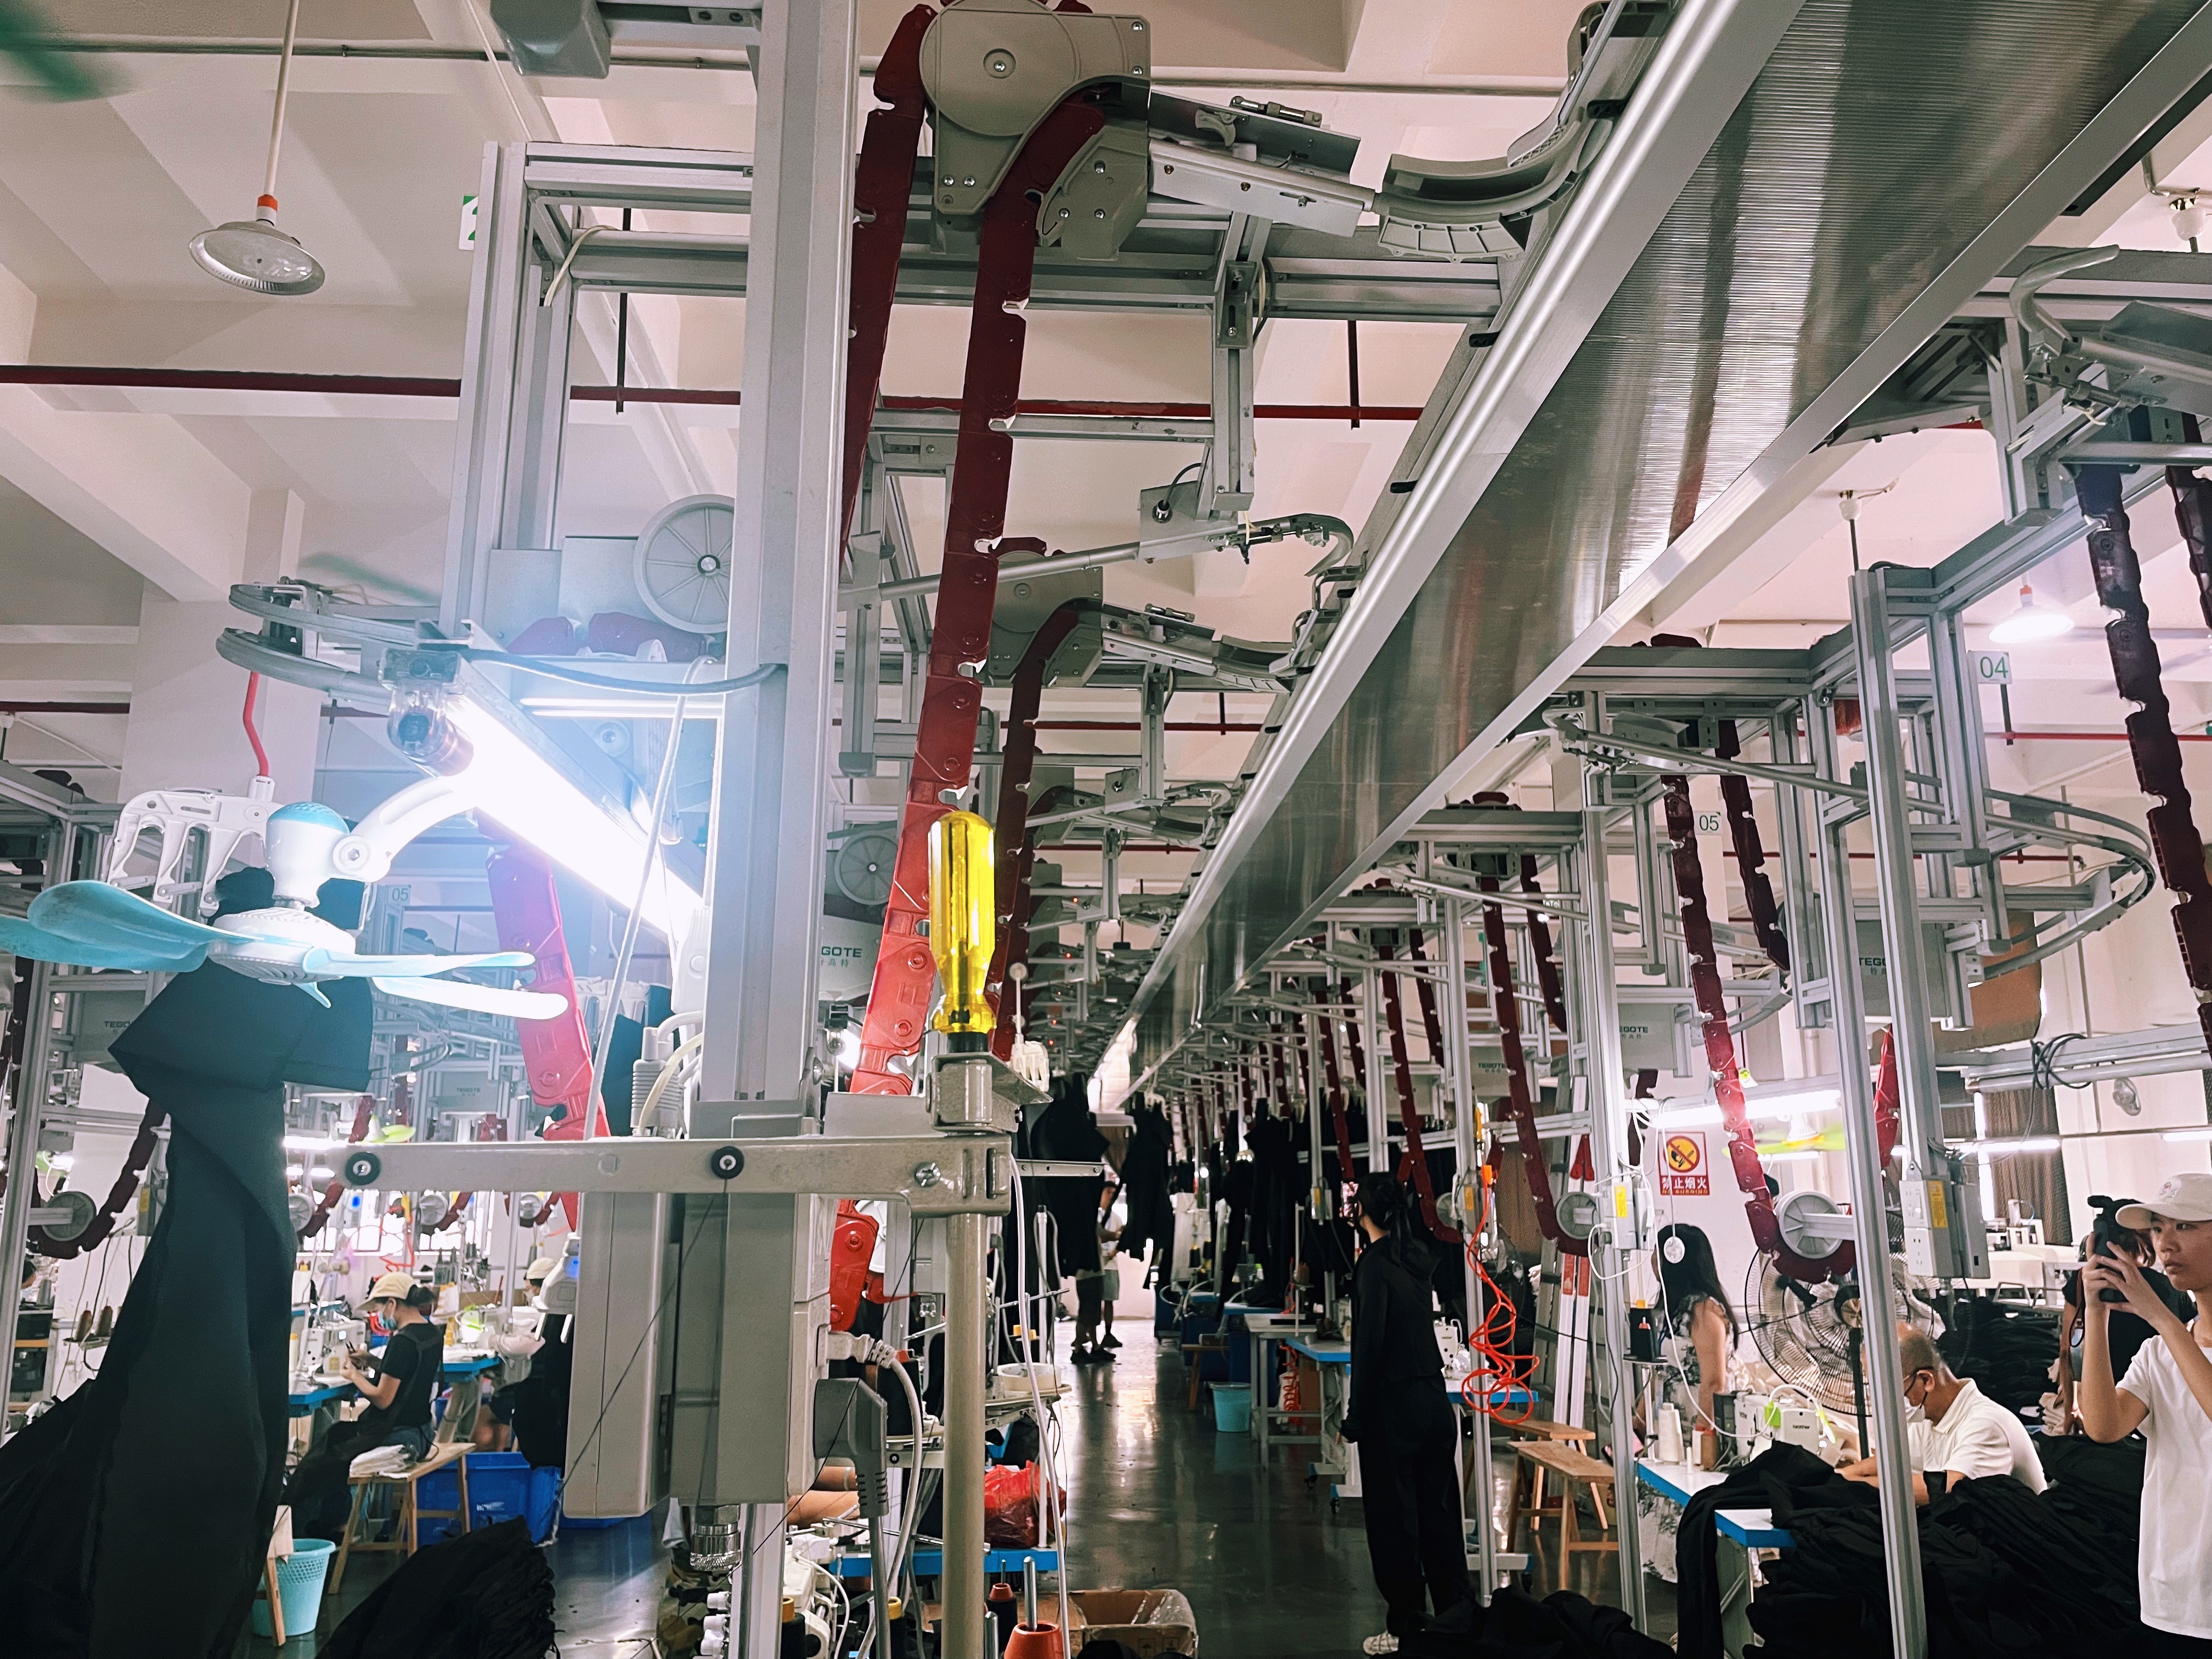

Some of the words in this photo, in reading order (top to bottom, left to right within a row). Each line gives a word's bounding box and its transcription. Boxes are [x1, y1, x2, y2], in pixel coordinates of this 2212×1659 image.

[1980, 656, 2008, 678] 04
[1699, 815, 1719, 831] 05
[392, 888, 409, 901] 05
[821, 946, 862, 958] GOTE
[1859, 957, 1886, 966] TEG
